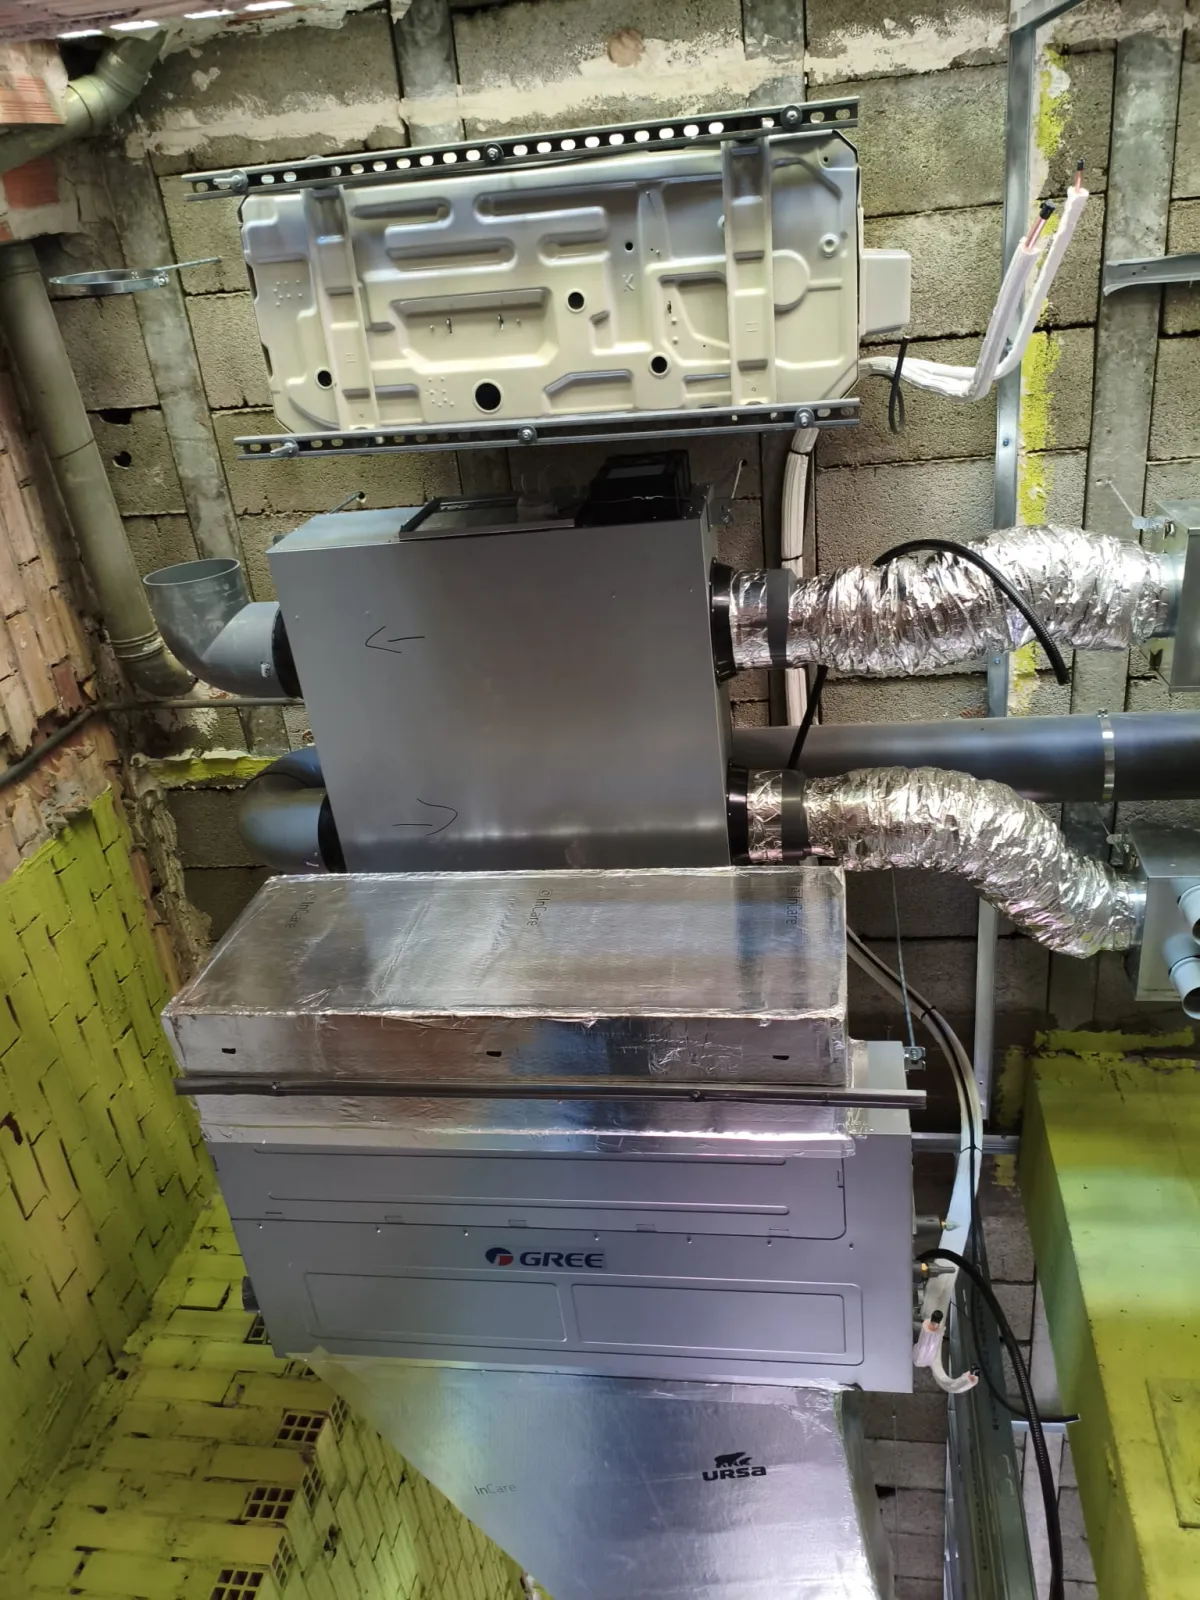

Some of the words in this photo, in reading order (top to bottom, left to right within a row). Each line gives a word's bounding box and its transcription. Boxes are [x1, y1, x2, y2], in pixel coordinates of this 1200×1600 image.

[527, 898, 551, 926] InCare
[786, 896, 803, 924] InCare
[519, 1251, 605, 1269] GREE
[474, 1483, 517, 1495] InCare
